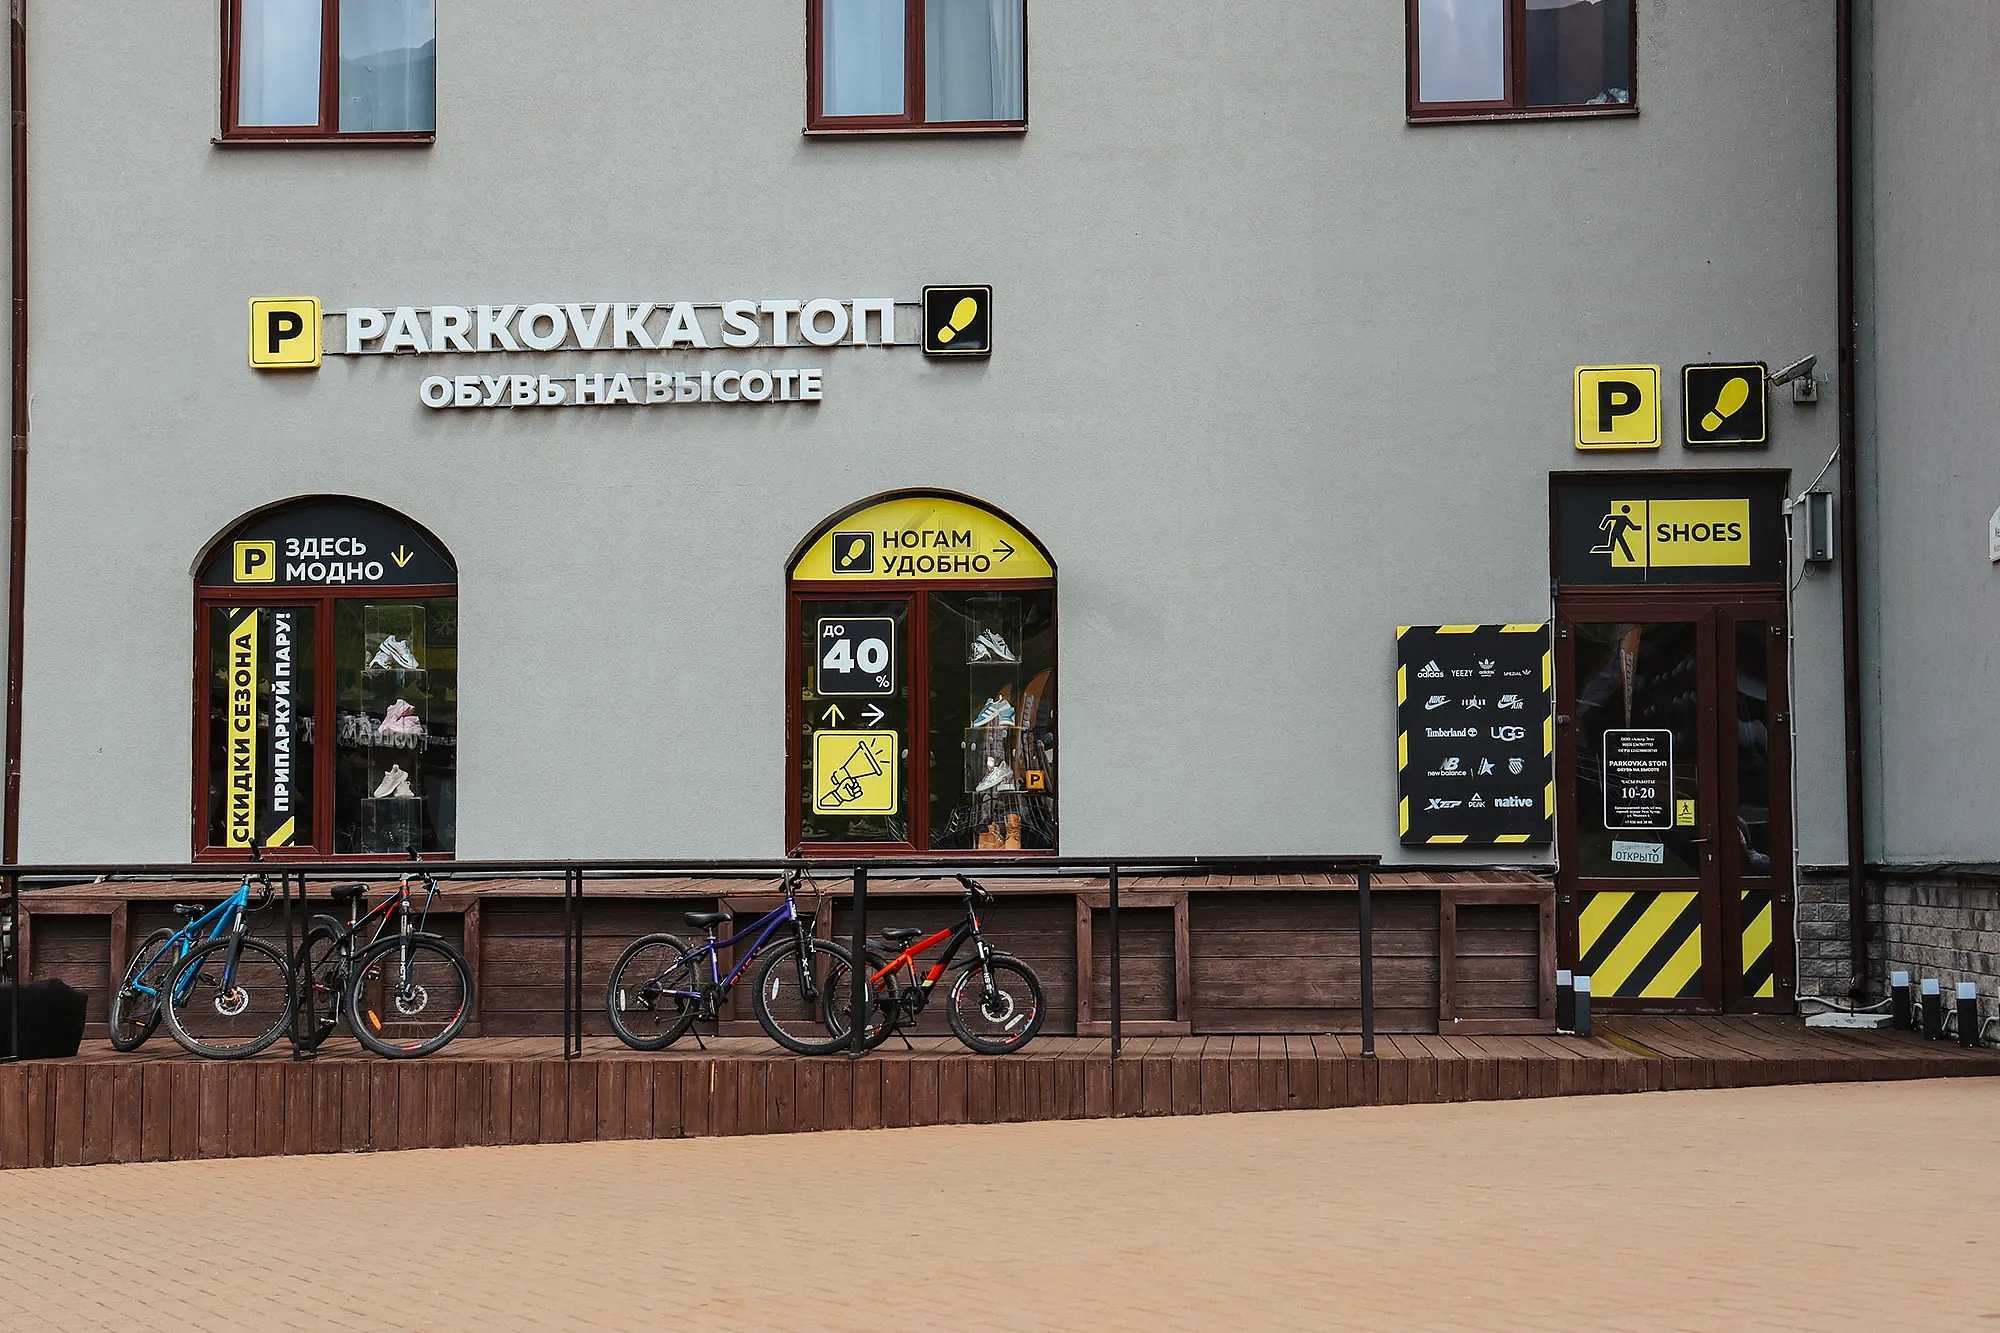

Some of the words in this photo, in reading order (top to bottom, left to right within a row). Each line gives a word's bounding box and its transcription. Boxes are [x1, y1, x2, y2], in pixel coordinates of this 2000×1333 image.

[268, 311, 303, 353] P
[346, 300, 706, 354] PARKOVKA
[722, 298, 895, 347] STOП
[420, 374, 568, 408] ОБУВЬ
[575, 371, 637, 405] НА
[646, 369, 823, 404] ВЫСОТЕ
[1598, 381, 1641, 432] P
[882, 530, 972, 549] НОГАМ
[1656, 522, 1742, 542] SHOES
[285, 537, 367, 558] ЗДЕСЬ
[245, 549, 266, 574] P
[882, 554, 991, 577] УДОБНО
[286, 562, 384, 584] МОДНО
[274, 612, 291, 676] ПАРУ!
[823, 638, 889, 674] 40
[233, 633, 252, 733] СЕЗОНА
[1417, 670, 1444, 678] adidas
[1451, 669, 1473, 677] YEEZY
[1425, 727, 1467, 738] Timberland
[1491, 726, 1525, 742] UGG
[271, 680, 290, 812] ПРИПАРКУЙ
[232, 739, 254, 843] СКИДКИ
[1030, 774, 1041, 786] P
[1494, 796, 1533, 808] native
[1621, 787, 1655, 799] 10-20
[1615, 851, 1660, 863] ОТКРЫТО
